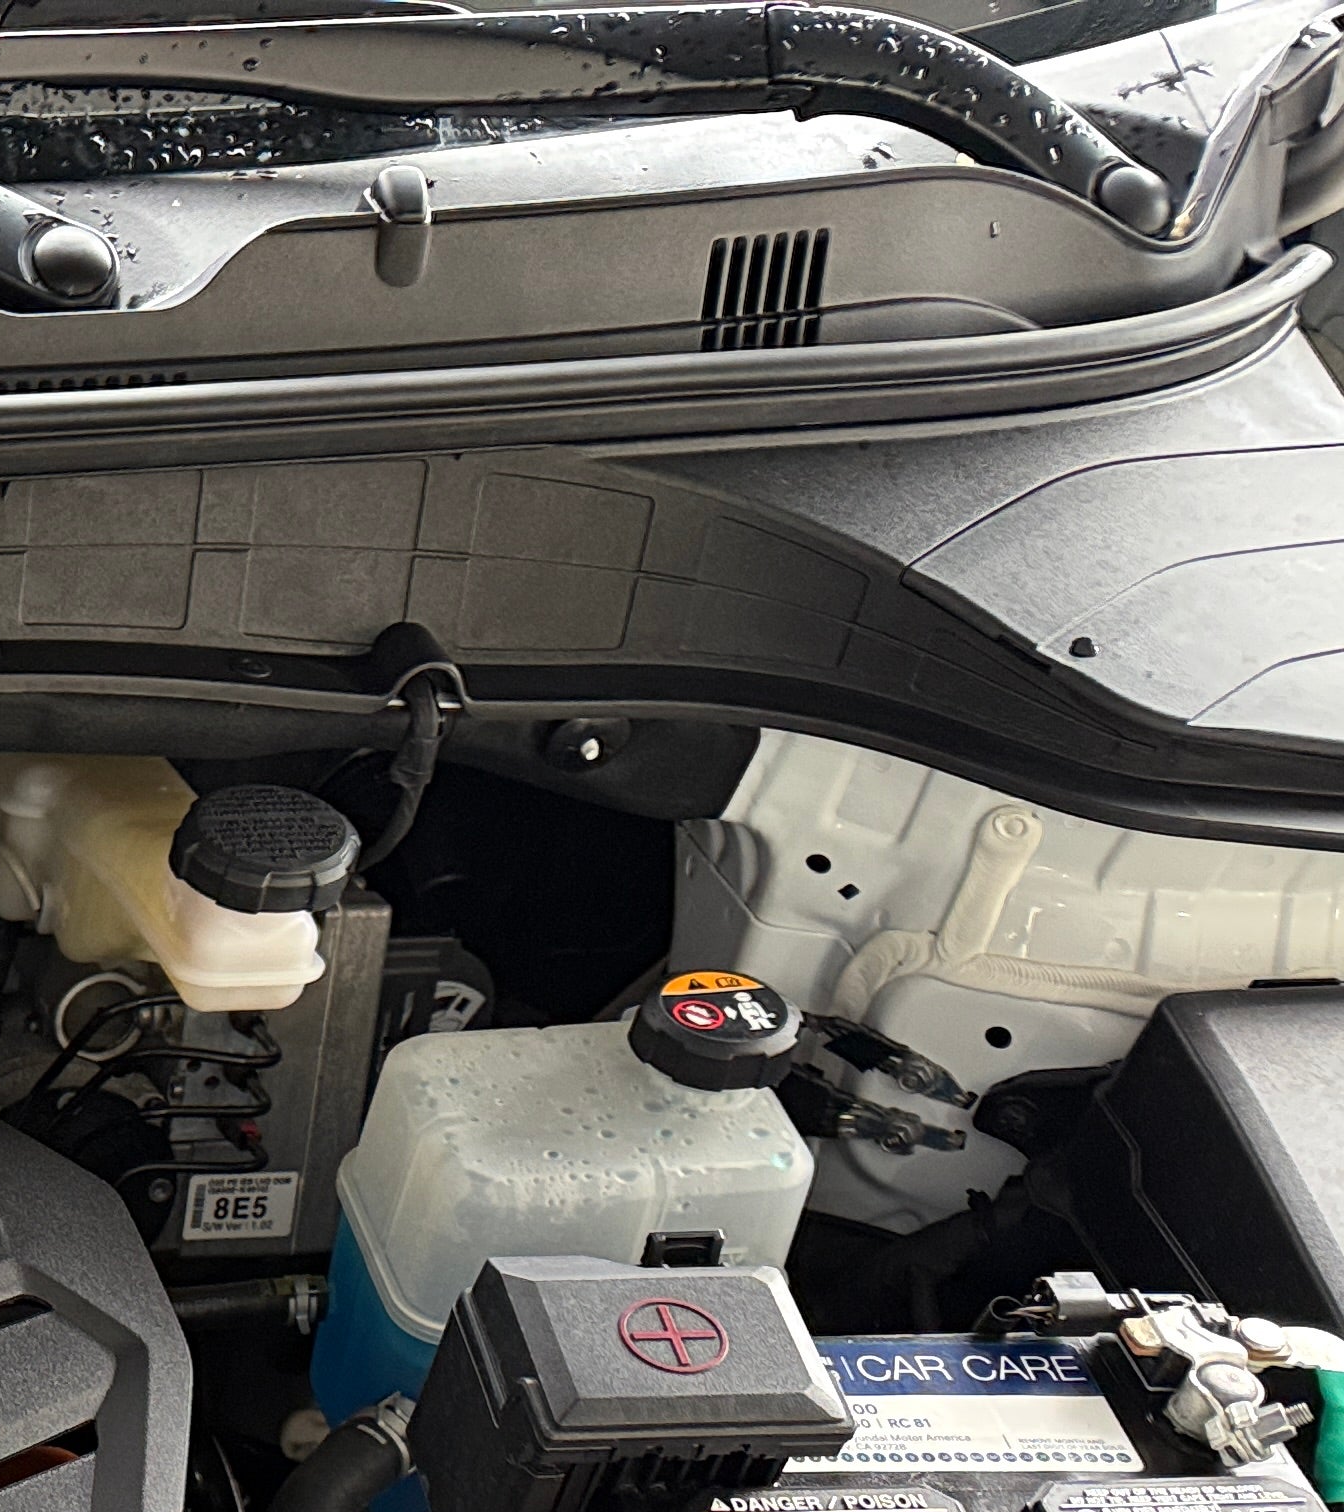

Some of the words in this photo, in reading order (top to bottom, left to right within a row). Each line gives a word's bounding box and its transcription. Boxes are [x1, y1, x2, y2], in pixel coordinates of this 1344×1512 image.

[214, 1196, 268, 1219] 8E5
[857, 1355, 953, 1381] CAR
[962, 1355, 1087, 1382] CARE
[888, 1418, 910, 1429] RC
[913, 1417, 931, 1428] 81
[731, 1496, 823, 1511] DANGER
[843, 1493, 928, 1509] POISON
